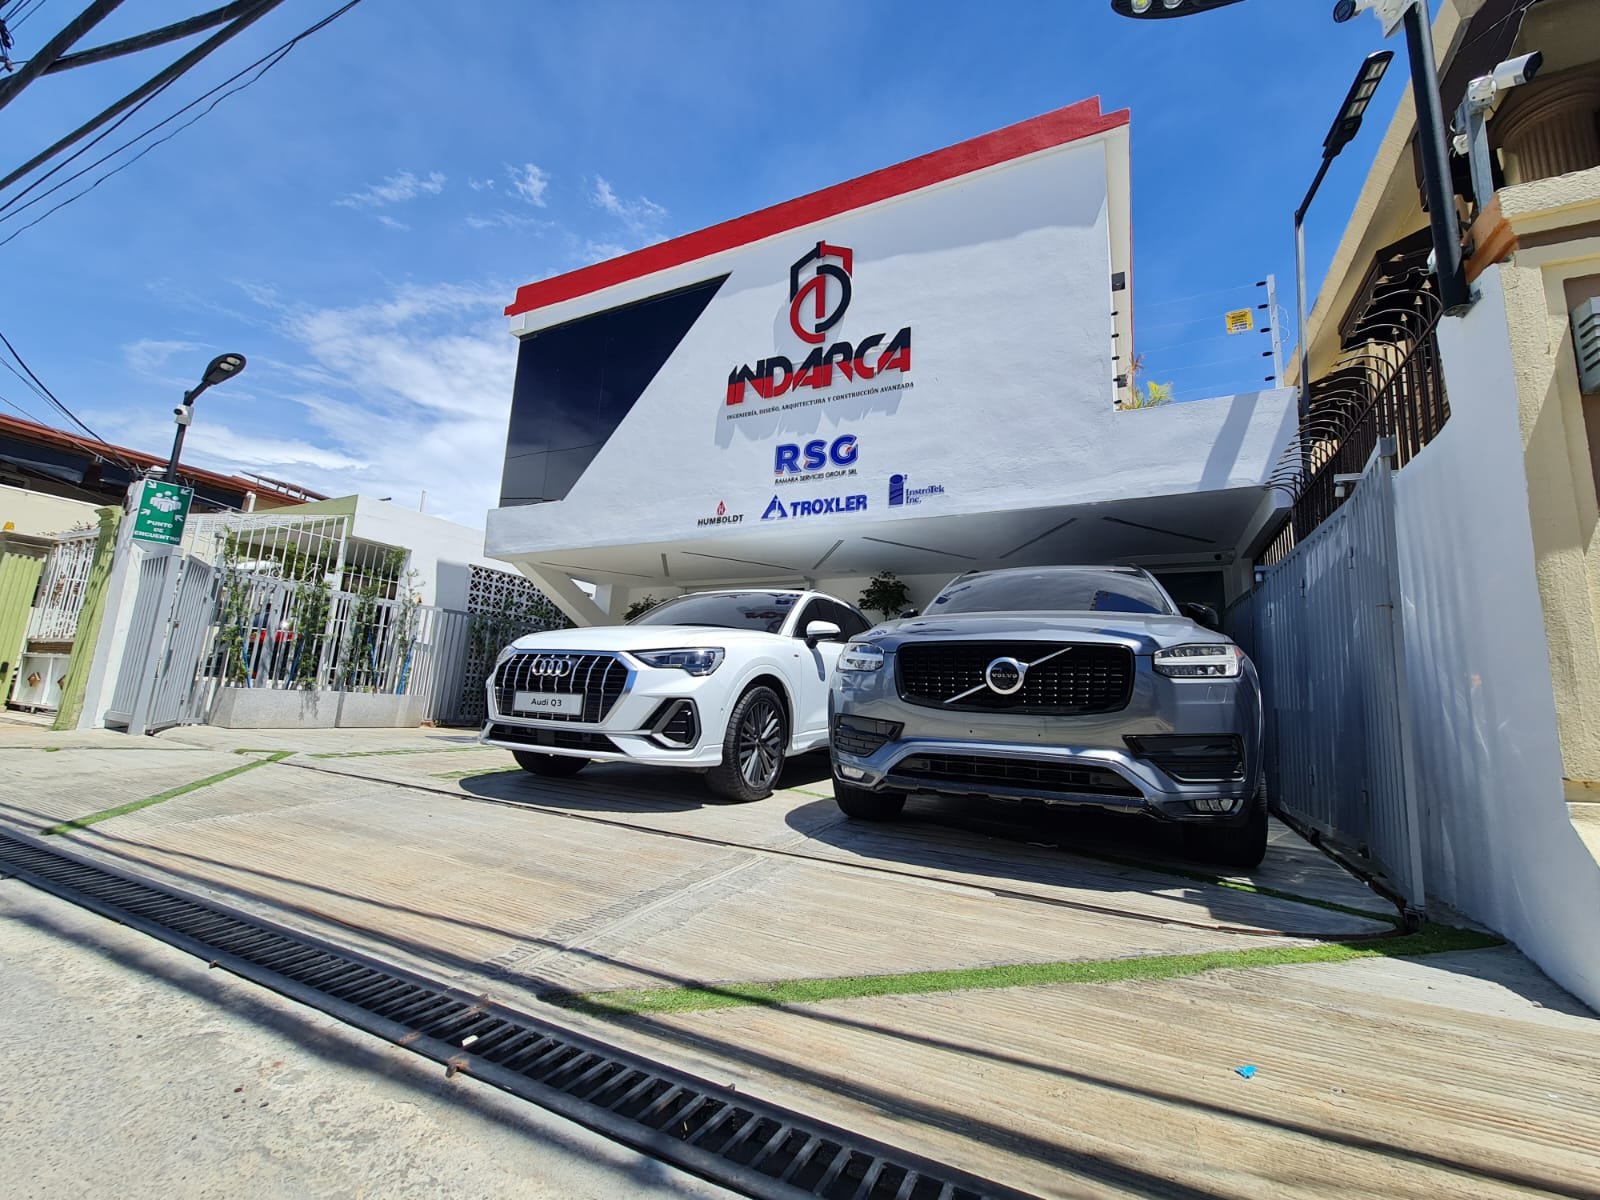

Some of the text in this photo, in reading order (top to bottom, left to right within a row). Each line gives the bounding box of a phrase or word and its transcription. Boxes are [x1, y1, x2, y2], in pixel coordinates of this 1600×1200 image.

[726, 326, 912, 405] INDARCA
[781, 397, 826, 410] ARQUITECTURA
[832, 387, 879, 402] CONSTRUCCIÓN
[880, 381, 914, 393] AVANZADA
[774, 434, 858, 475] RSG
[799, 472, 825, 481] SERVICES
[906, 485, 945, 496] InstroTek
[790, 494, 868, 517] TROXLER
[146, 520, 173, 528] PUNTO
[697, 514, 744, 526] HUMBOLDT
[134, 530, 180, 541] ENCUENTRO
[531, 698, 549, 706] Audi
